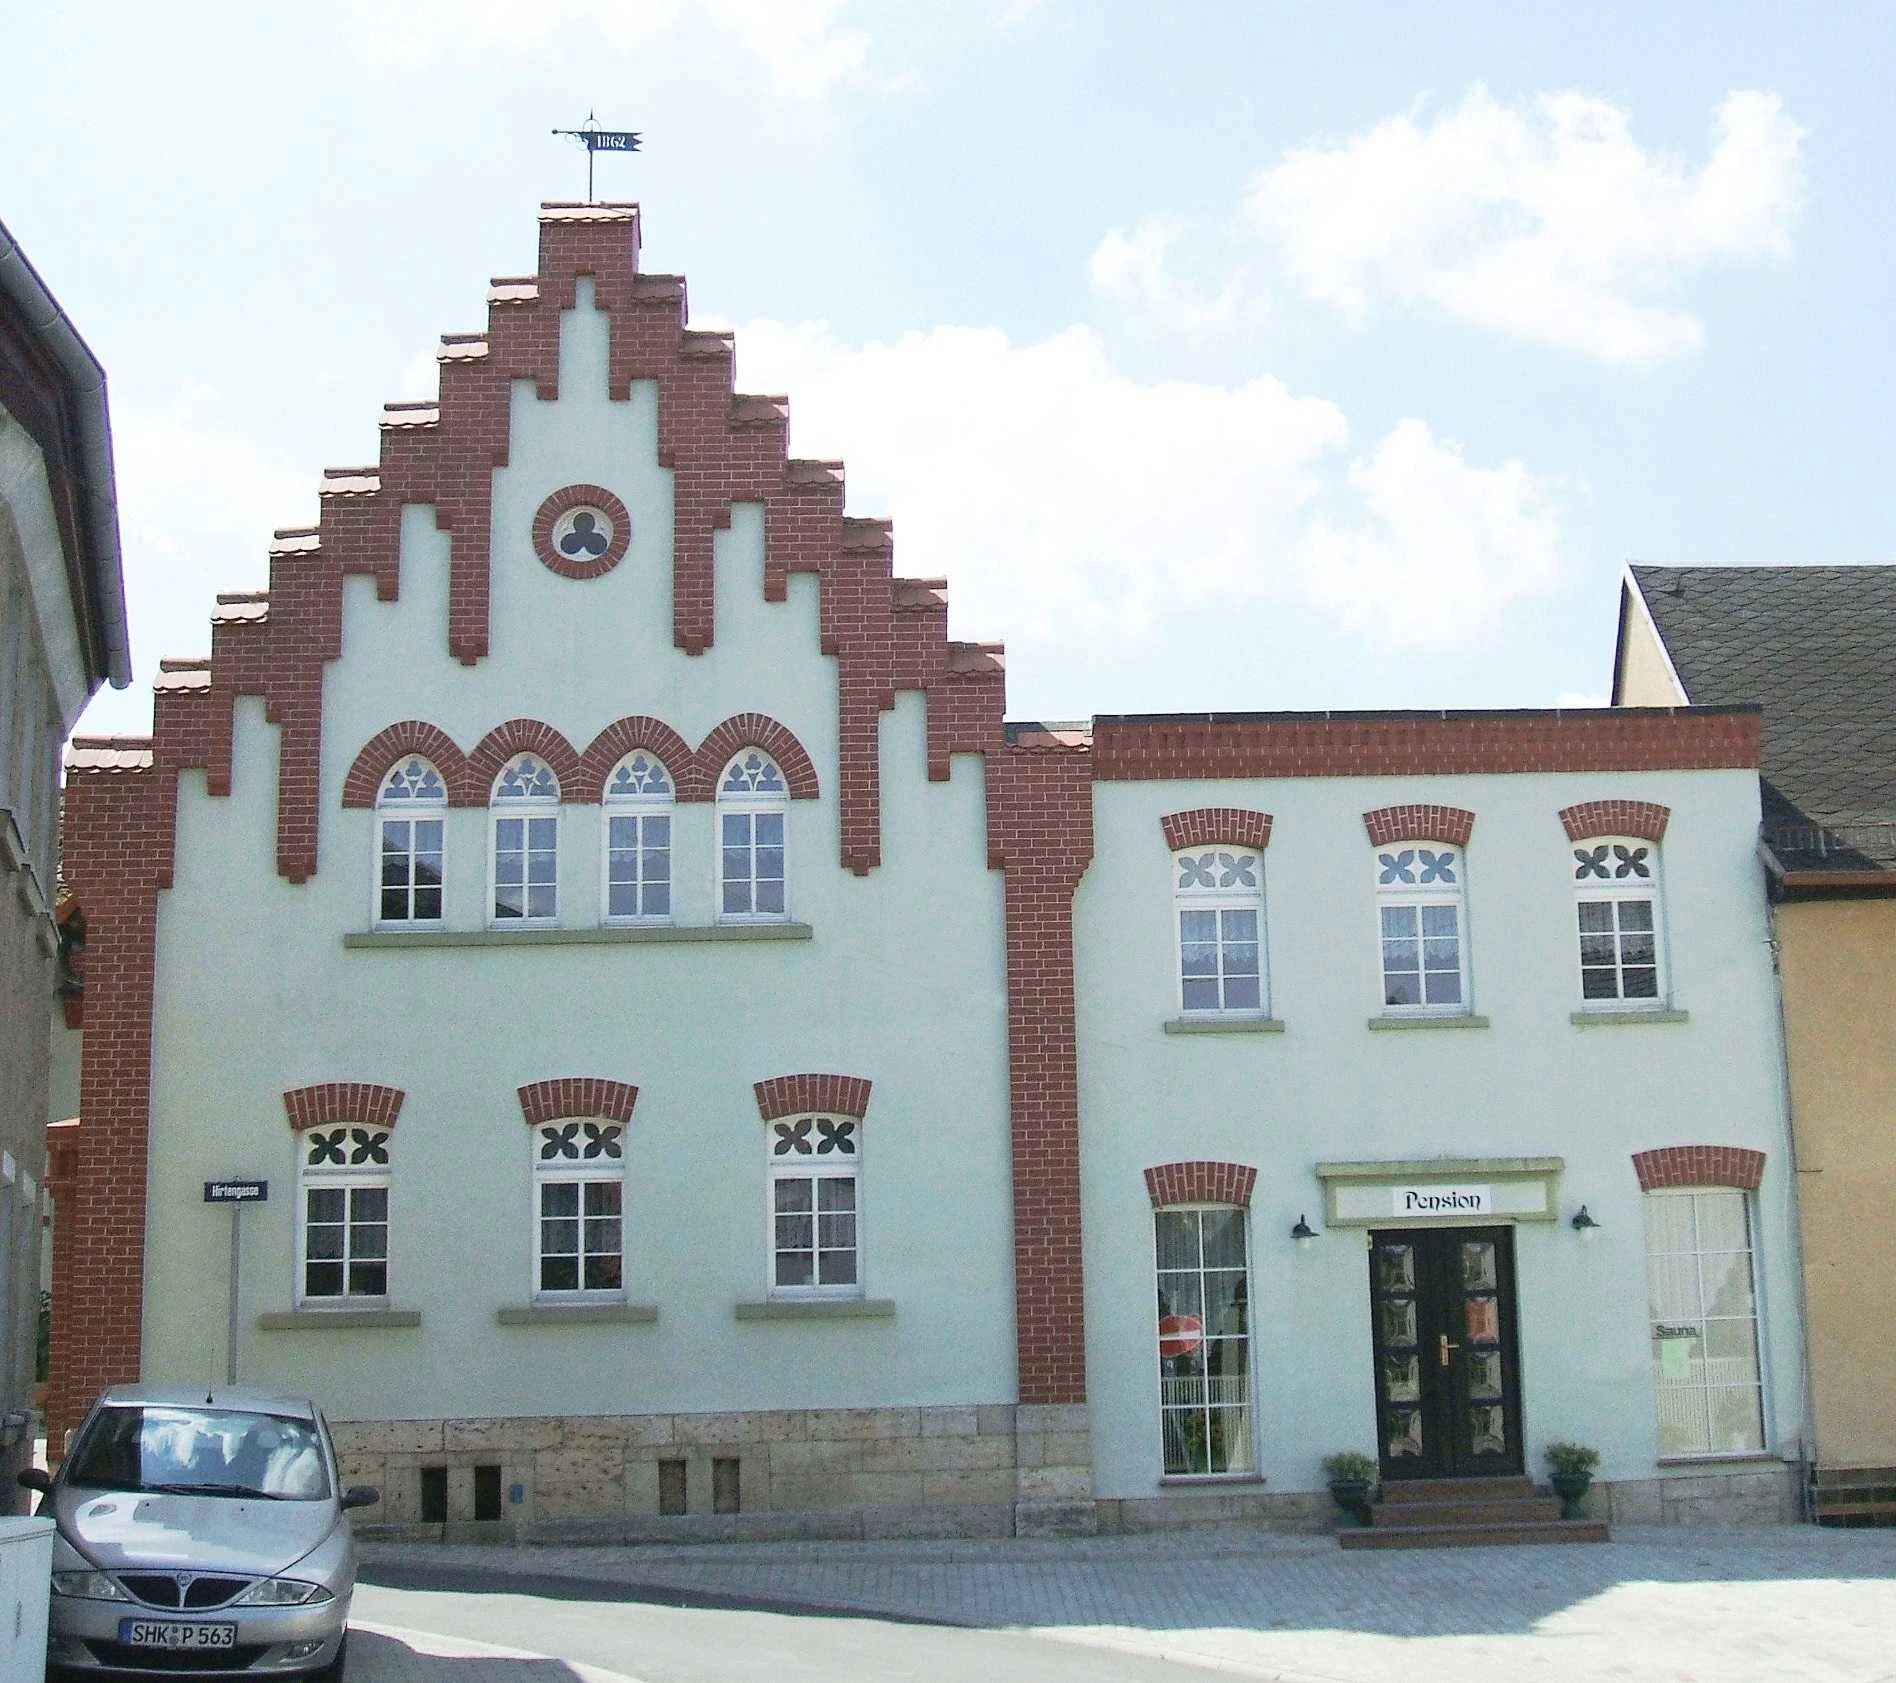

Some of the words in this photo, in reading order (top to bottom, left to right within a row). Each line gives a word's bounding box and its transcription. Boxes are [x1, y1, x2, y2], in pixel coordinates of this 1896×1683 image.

[597, 135, 626, 148] 1862
[1405, 1191, 1481, 1211] Pension
[1656, 1325, 1697, 1337] Sauna
[132, 1624, 168, 1644] SHK
[182, 1627, 193, 1644] P
[198, 1627, 233, 1645] 563
